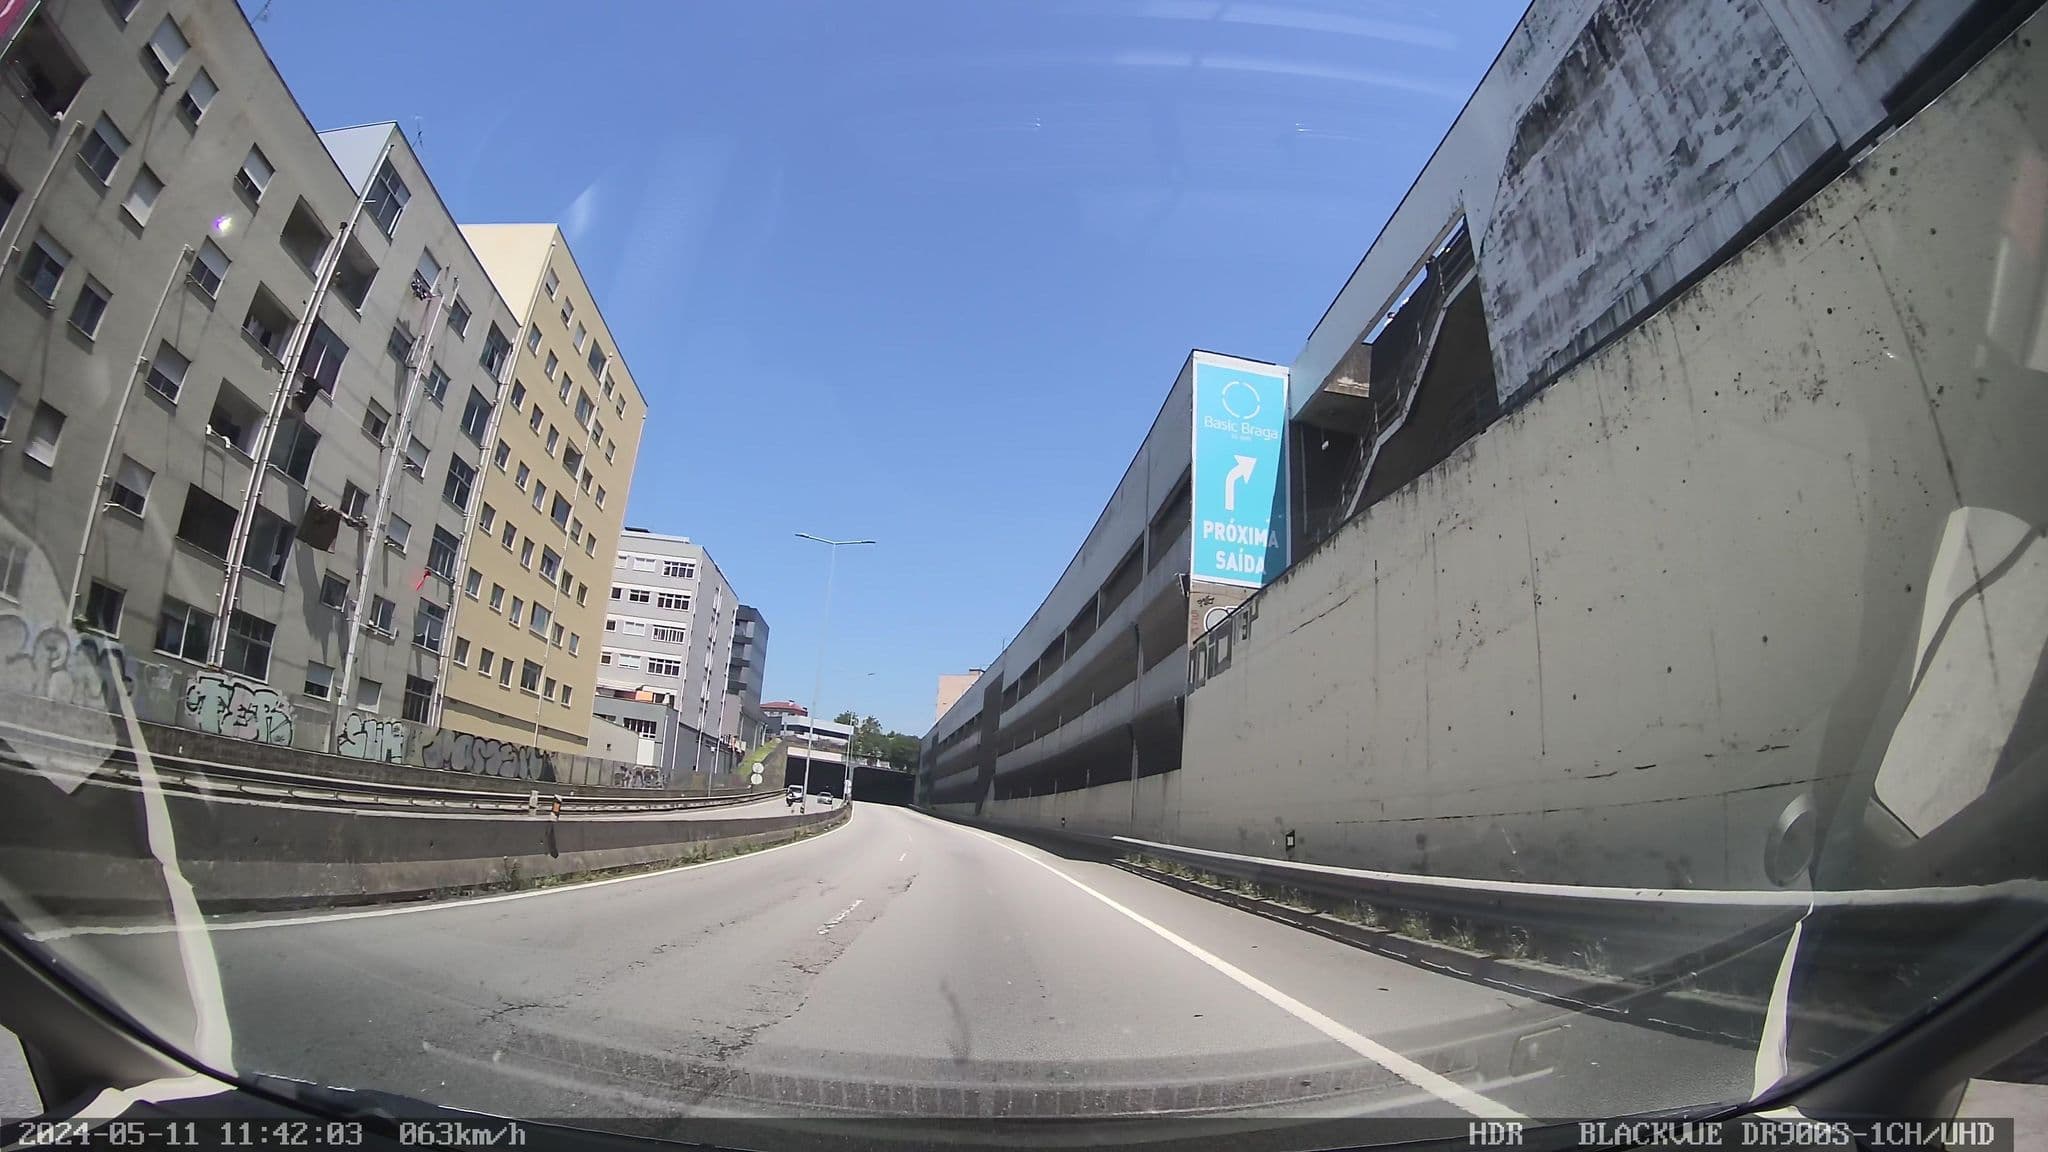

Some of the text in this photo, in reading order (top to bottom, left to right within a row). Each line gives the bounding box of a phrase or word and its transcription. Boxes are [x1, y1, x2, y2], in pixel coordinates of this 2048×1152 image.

[1204, 415, 1238, 433] Basic
[1241, 422, 1279, 441] Braga
[1203, 518, 1279, 549] PRÓXIMA
[1215, 548, 1267, 575] SAÍDA
